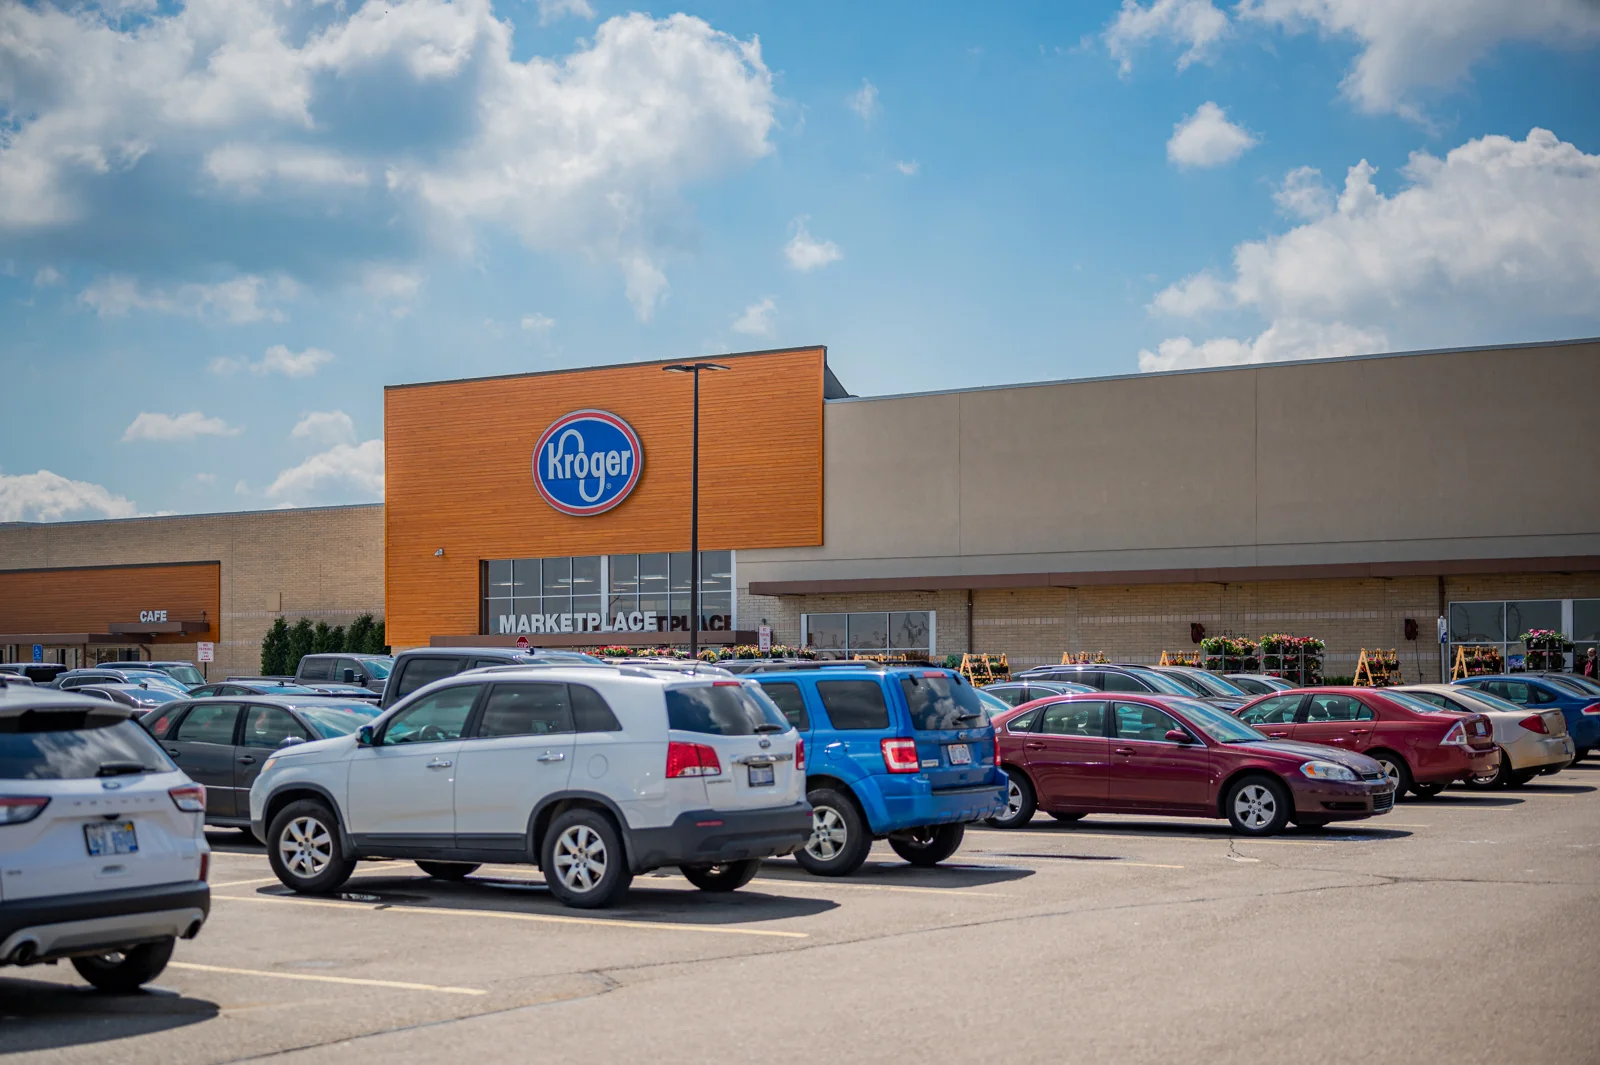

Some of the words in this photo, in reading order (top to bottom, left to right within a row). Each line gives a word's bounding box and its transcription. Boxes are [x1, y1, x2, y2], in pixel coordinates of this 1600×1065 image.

[547, 428, 631, 503] Kroger
[140, 610, 167, 622] CAFE
[499, 611, 657, 634] MARKETPLACE
